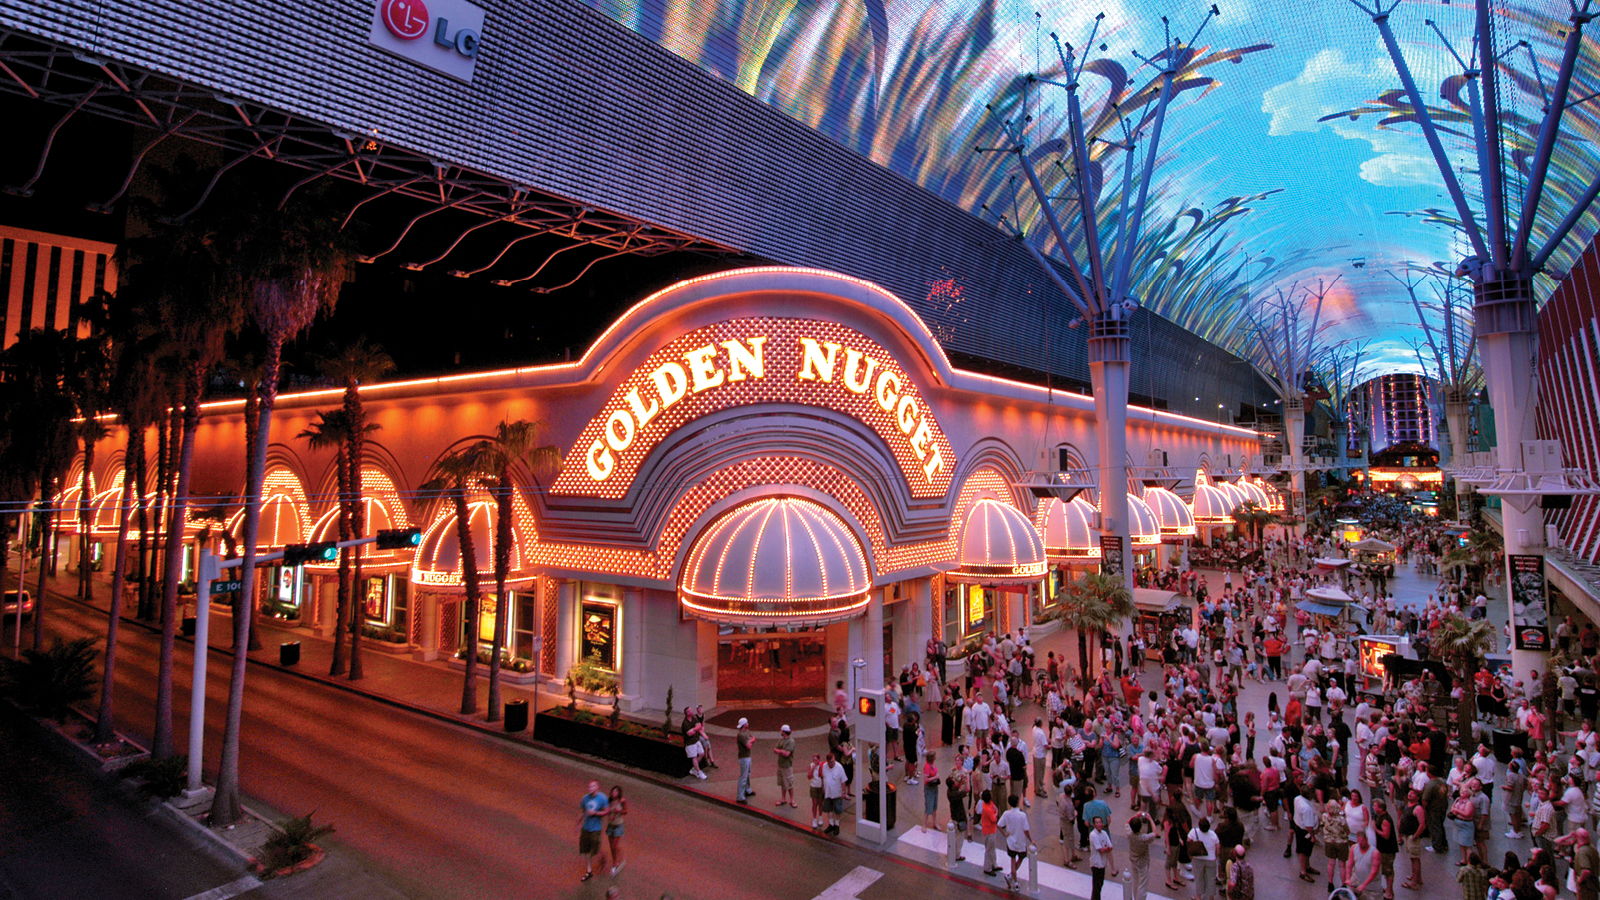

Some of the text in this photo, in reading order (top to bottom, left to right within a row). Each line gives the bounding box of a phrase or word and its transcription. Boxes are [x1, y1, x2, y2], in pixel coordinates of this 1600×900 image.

[434, 17, 480, 58] LG
[585, 336, 946, 485] GOLDEN NUGGET
[424, 573, 462, 583] NUGGET
